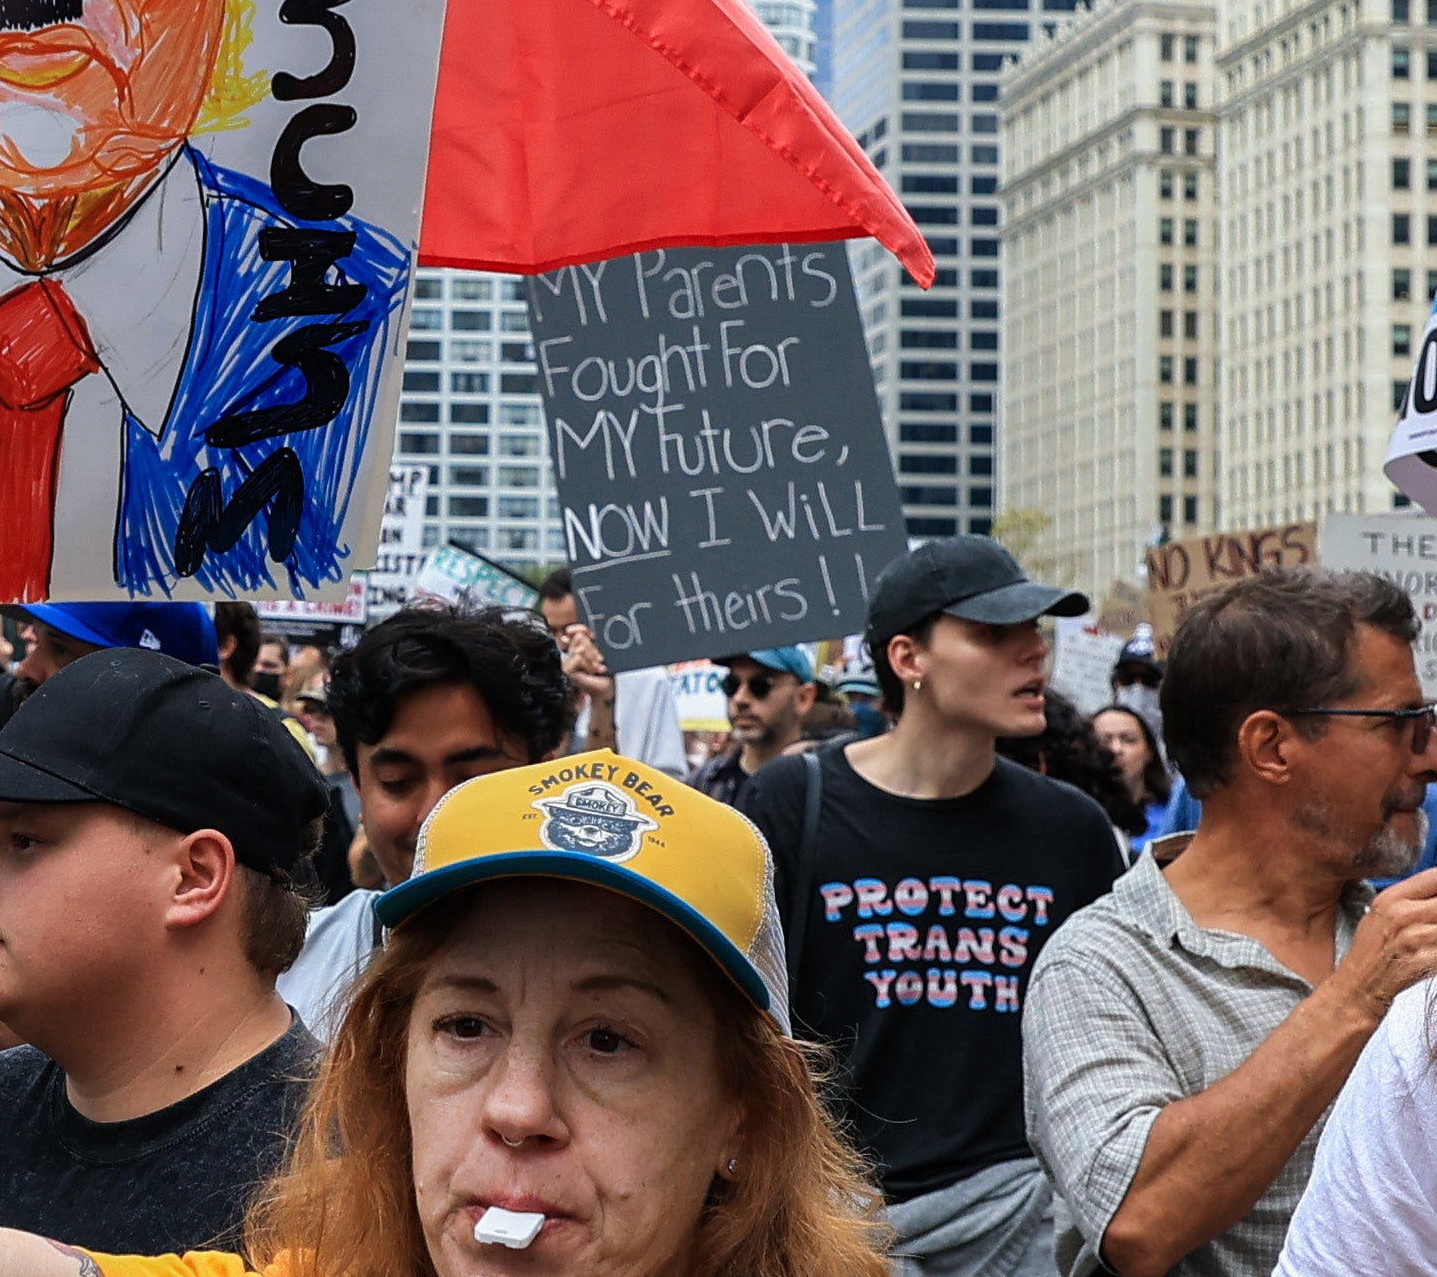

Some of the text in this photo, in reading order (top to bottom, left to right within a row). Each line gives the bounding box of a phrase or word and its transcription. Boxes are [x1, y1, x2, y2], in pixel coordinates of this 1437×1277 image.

[634, 243, 837, 320] Parents
[539, 320, 800, 413] Fought For
[554, 404, 849, 480] MY Future,
[564, 496, 669, 562] NOW
[690, 486, 732, 549] I
[1147, 545, 1190, 593] NO
[577, 585, 652, 650] For
[528, 762, 675, 818] SMOKEY BEAR
[575, 798, 619, 814] SMOKEY
[819, 875, 1054, 927] PROTECT
[853, 921, 1030, 969] TRANS
[863, 967, 1019, 1014] YOUTH
